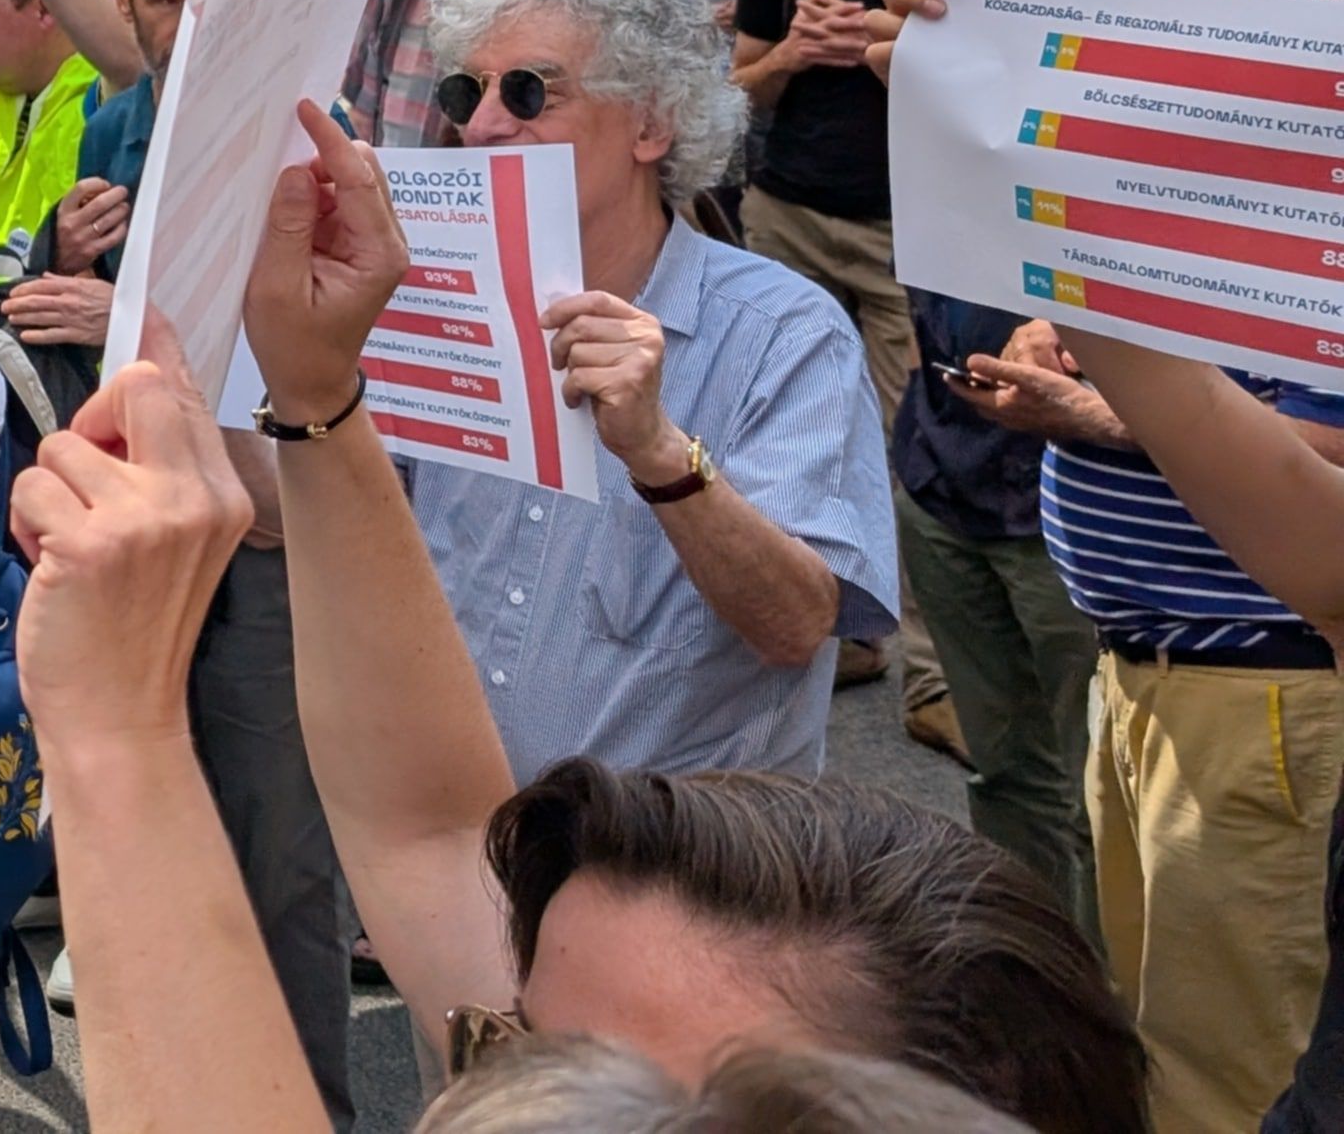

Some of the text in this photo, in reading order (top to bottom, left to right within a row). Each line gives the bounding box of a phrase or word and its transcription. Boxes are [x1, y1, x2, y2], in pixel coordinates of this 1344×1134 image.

[1095, 11, 1112, 25] ÉS
[1115, 16, 1202, 37] REGIONÁLIS
[1207, 27, 1300, 49] TUDOMÁNYI
[1303, 39, 1344, 56] KUTA
[1083, 89, 1273, 130] BÖLCSÉSZETTUDOMÁNYI
[1116, 179, 1344, 227] NYELVTUDOMÁNYI KUTATÓ
[424, 271, 458, 286] 93%
[1061, 248, 1259, 301] TÁRSADALOMTUDOMÁNYI
[442, 323, 474, 338] 92%
[364, 339, 501, 369] DOMÁNYI KUTATÓKÖZPONT
[451, 375, 482, 392] 88%
[364, 393, 511, 427] TUDOMÁNYI KUTATÓKÖZPONT
[462, 435, 494, 451] 83%
